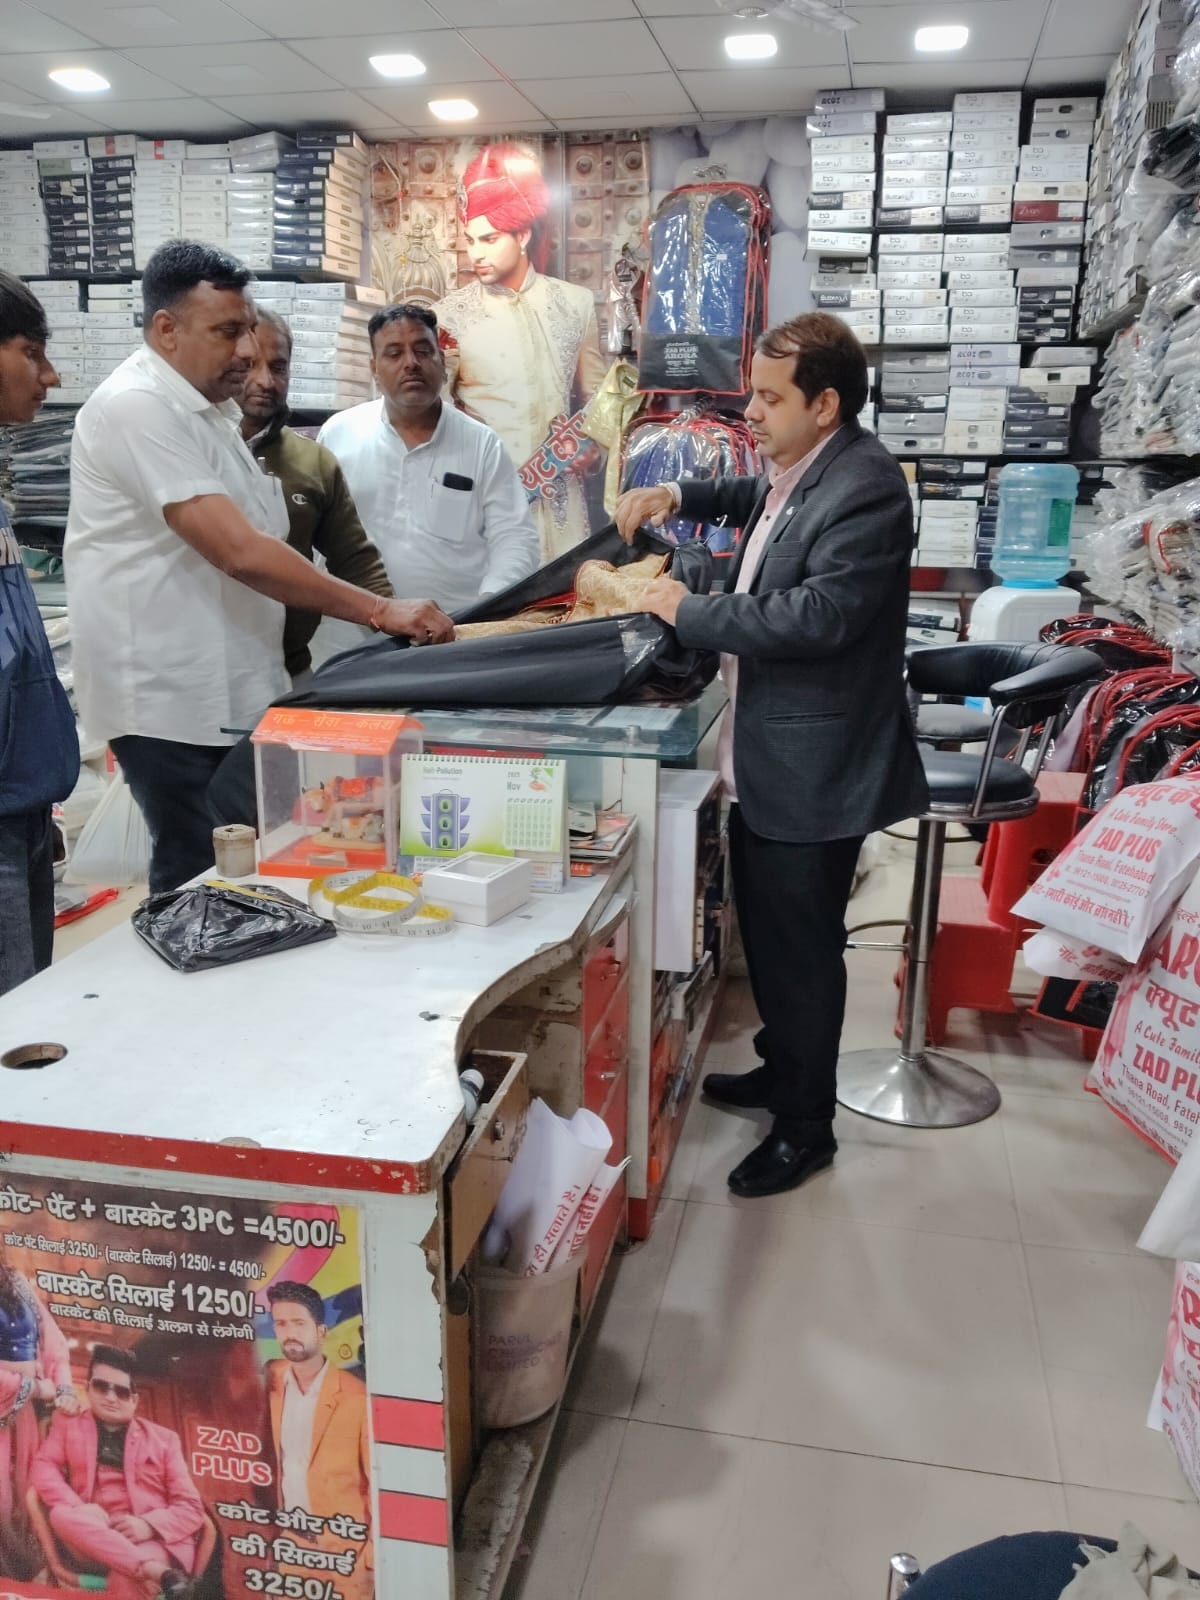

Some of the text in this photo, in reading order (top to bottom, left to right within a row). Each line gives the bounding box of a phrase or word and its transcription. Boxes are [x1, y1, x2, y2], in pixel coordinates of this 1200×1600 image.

[1122, 833, 1163, 864] PLUS
[1122, 1063, 1144, 1091] Thana
[1133, 1043, 1171, 1084] ZAD
[81, 1198, 96, 1218] +
[180, 1204, 235, 1236] 3PC
[180, 1252, 215, 1272] 1250/-
[229, 1259, 265, 1280] 4500/-
[107, 1274, 175, 1313] सिलाई
[181, 1283, 265, 1318] 1250/-
[92, 1306, 111, 1323] की
[112, 1308, 154, 1331] सिलाई
[194, 1320, 209, 1336] से
[197, 1426, 262, 1455] ZAD
[192, 1452, 273, 1487] PLUS
[216, 1500, 271, 1525] कोट
[274, 1507, 325, 1534] और
[230, 1533, 356, 1577] की सिलाई
